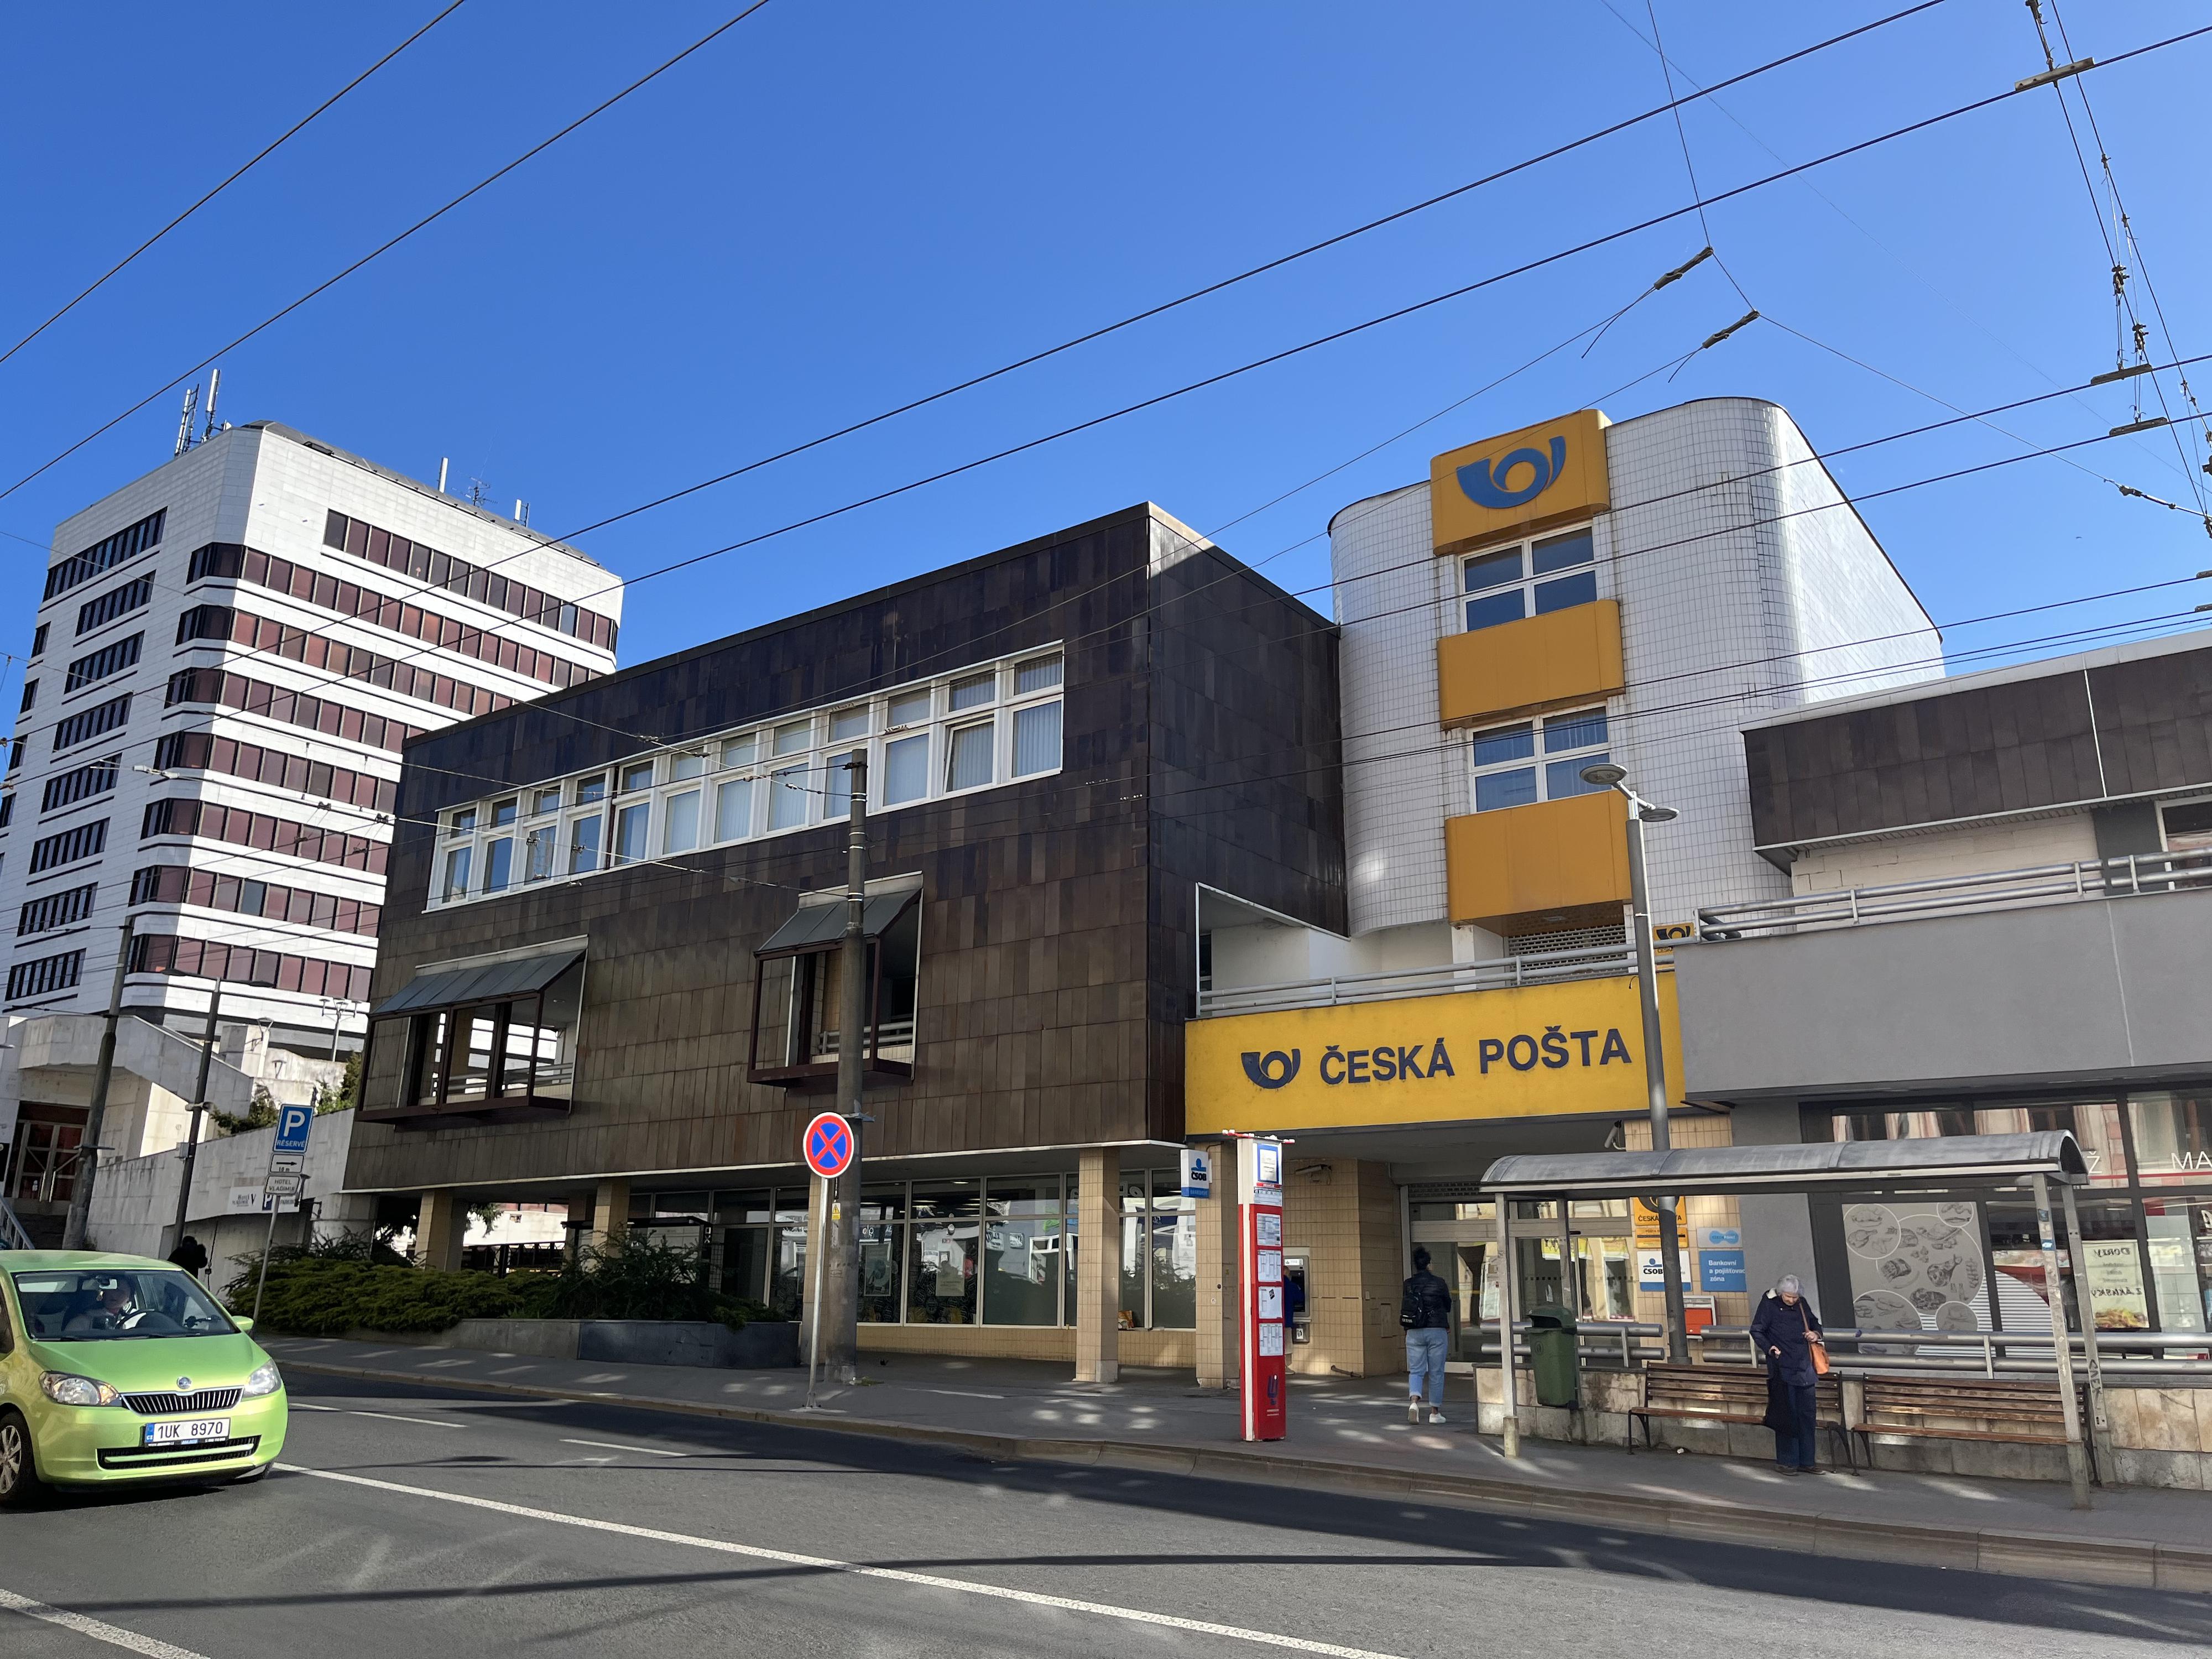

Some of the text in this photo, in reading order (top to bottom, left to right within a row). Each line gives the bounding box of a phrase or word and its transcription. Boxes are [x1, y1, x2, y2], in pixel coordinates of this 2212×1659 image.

[1319, 1025, 1632, 1085] ČESKÁ POŠTA
[283, 1110, 305, 1137] P
[276, 1139, 305, 1148] RÉSERVÉ
[1191, 1171, 1207, 1181] ČSOB
[158, 1422, 223, 1439] 1UK 8970
